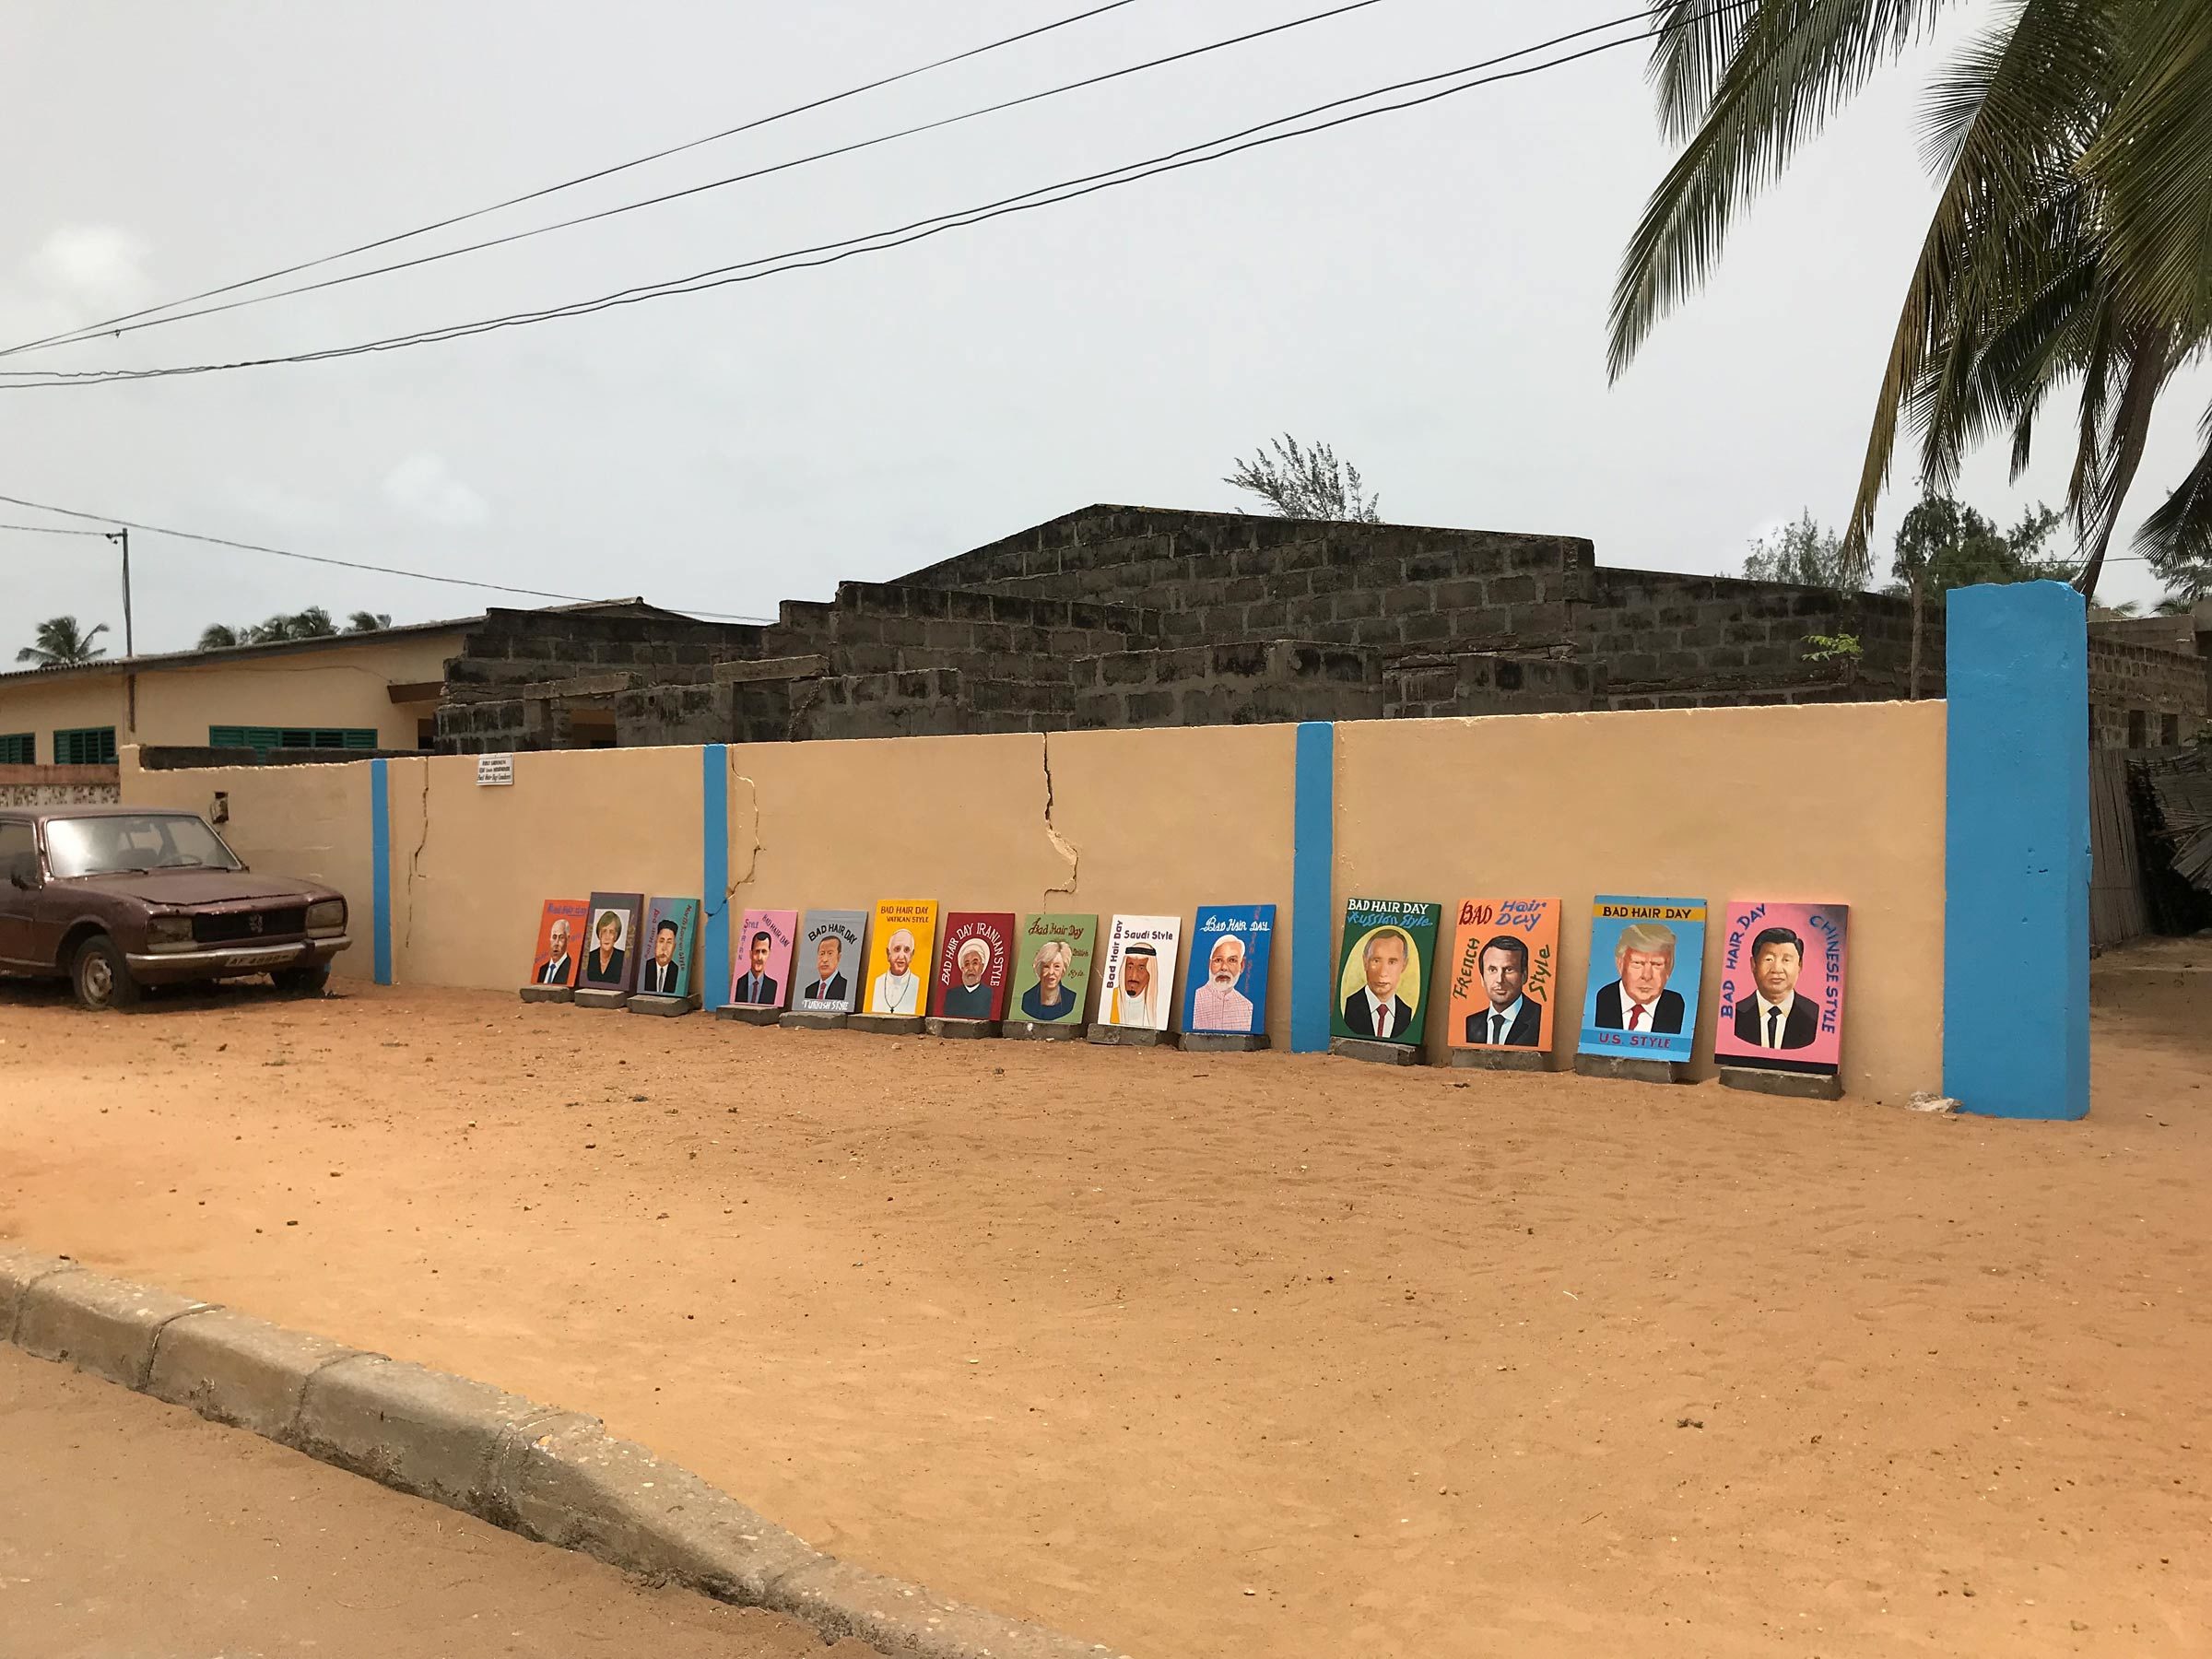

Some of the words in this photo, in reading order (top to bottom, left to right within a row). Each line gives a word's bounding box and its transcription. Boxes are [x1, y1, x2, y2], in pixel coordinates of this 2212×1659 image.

[881, 906, 894, 914] BAD
[896, 906, 913, 914] HAIR
[1348, 900, 1370, 911] BAD
[1371, 901, 1400, 913] HAIR
[1403, 903, 1429, 914] DAY
[1459, 900, 1492, 925] BAD
[1603, 906, 1628, 917] BAD
[1631, 907, 1660, 918] HAIR
[1665, 909, 1691, 919] DAY
[1736, 903, 1766, 931] DAY
[1113, 920, 1124, 939] Day
[1347, 912, 1398, 926] Russian
[770, 924, 782, 938] HAIR
[808, 924, 827, 941] BAD
[829, 924, 845, 936] HAIR
[844, 929, 857, 945] DAY
[957, 923, 974, 939] DAY
[977, 923, 1004, 958] IRANIAN
[1050, 923, 1068, 935] Hair
[1068, 924, 1084, 939] Day
[1124, 930, 1150, 939] Saudi
[946, 937, 959, 959] HAIR
[1111, 942, 1120, 962] Hair
[1726, 931, 1745, 970] HAIR
[1809, 915, 1840, 982] CHINESE
[941, 960, 952, 985] BAD
[990, 957, 1004, 986] STYLE
[1106, 965, 1116, 989] Bad
[1529, 944, 1551, 1002] Style
[802, 999, 831, 1009] TURKISH
[1721, 980, 1735, 1019] BAD
[1821, 987, 1838, 1034] STYLE
[1599, 1032, 1624, 1044] U.S.
[1630, 1036, 1670, 1048] STYLE
